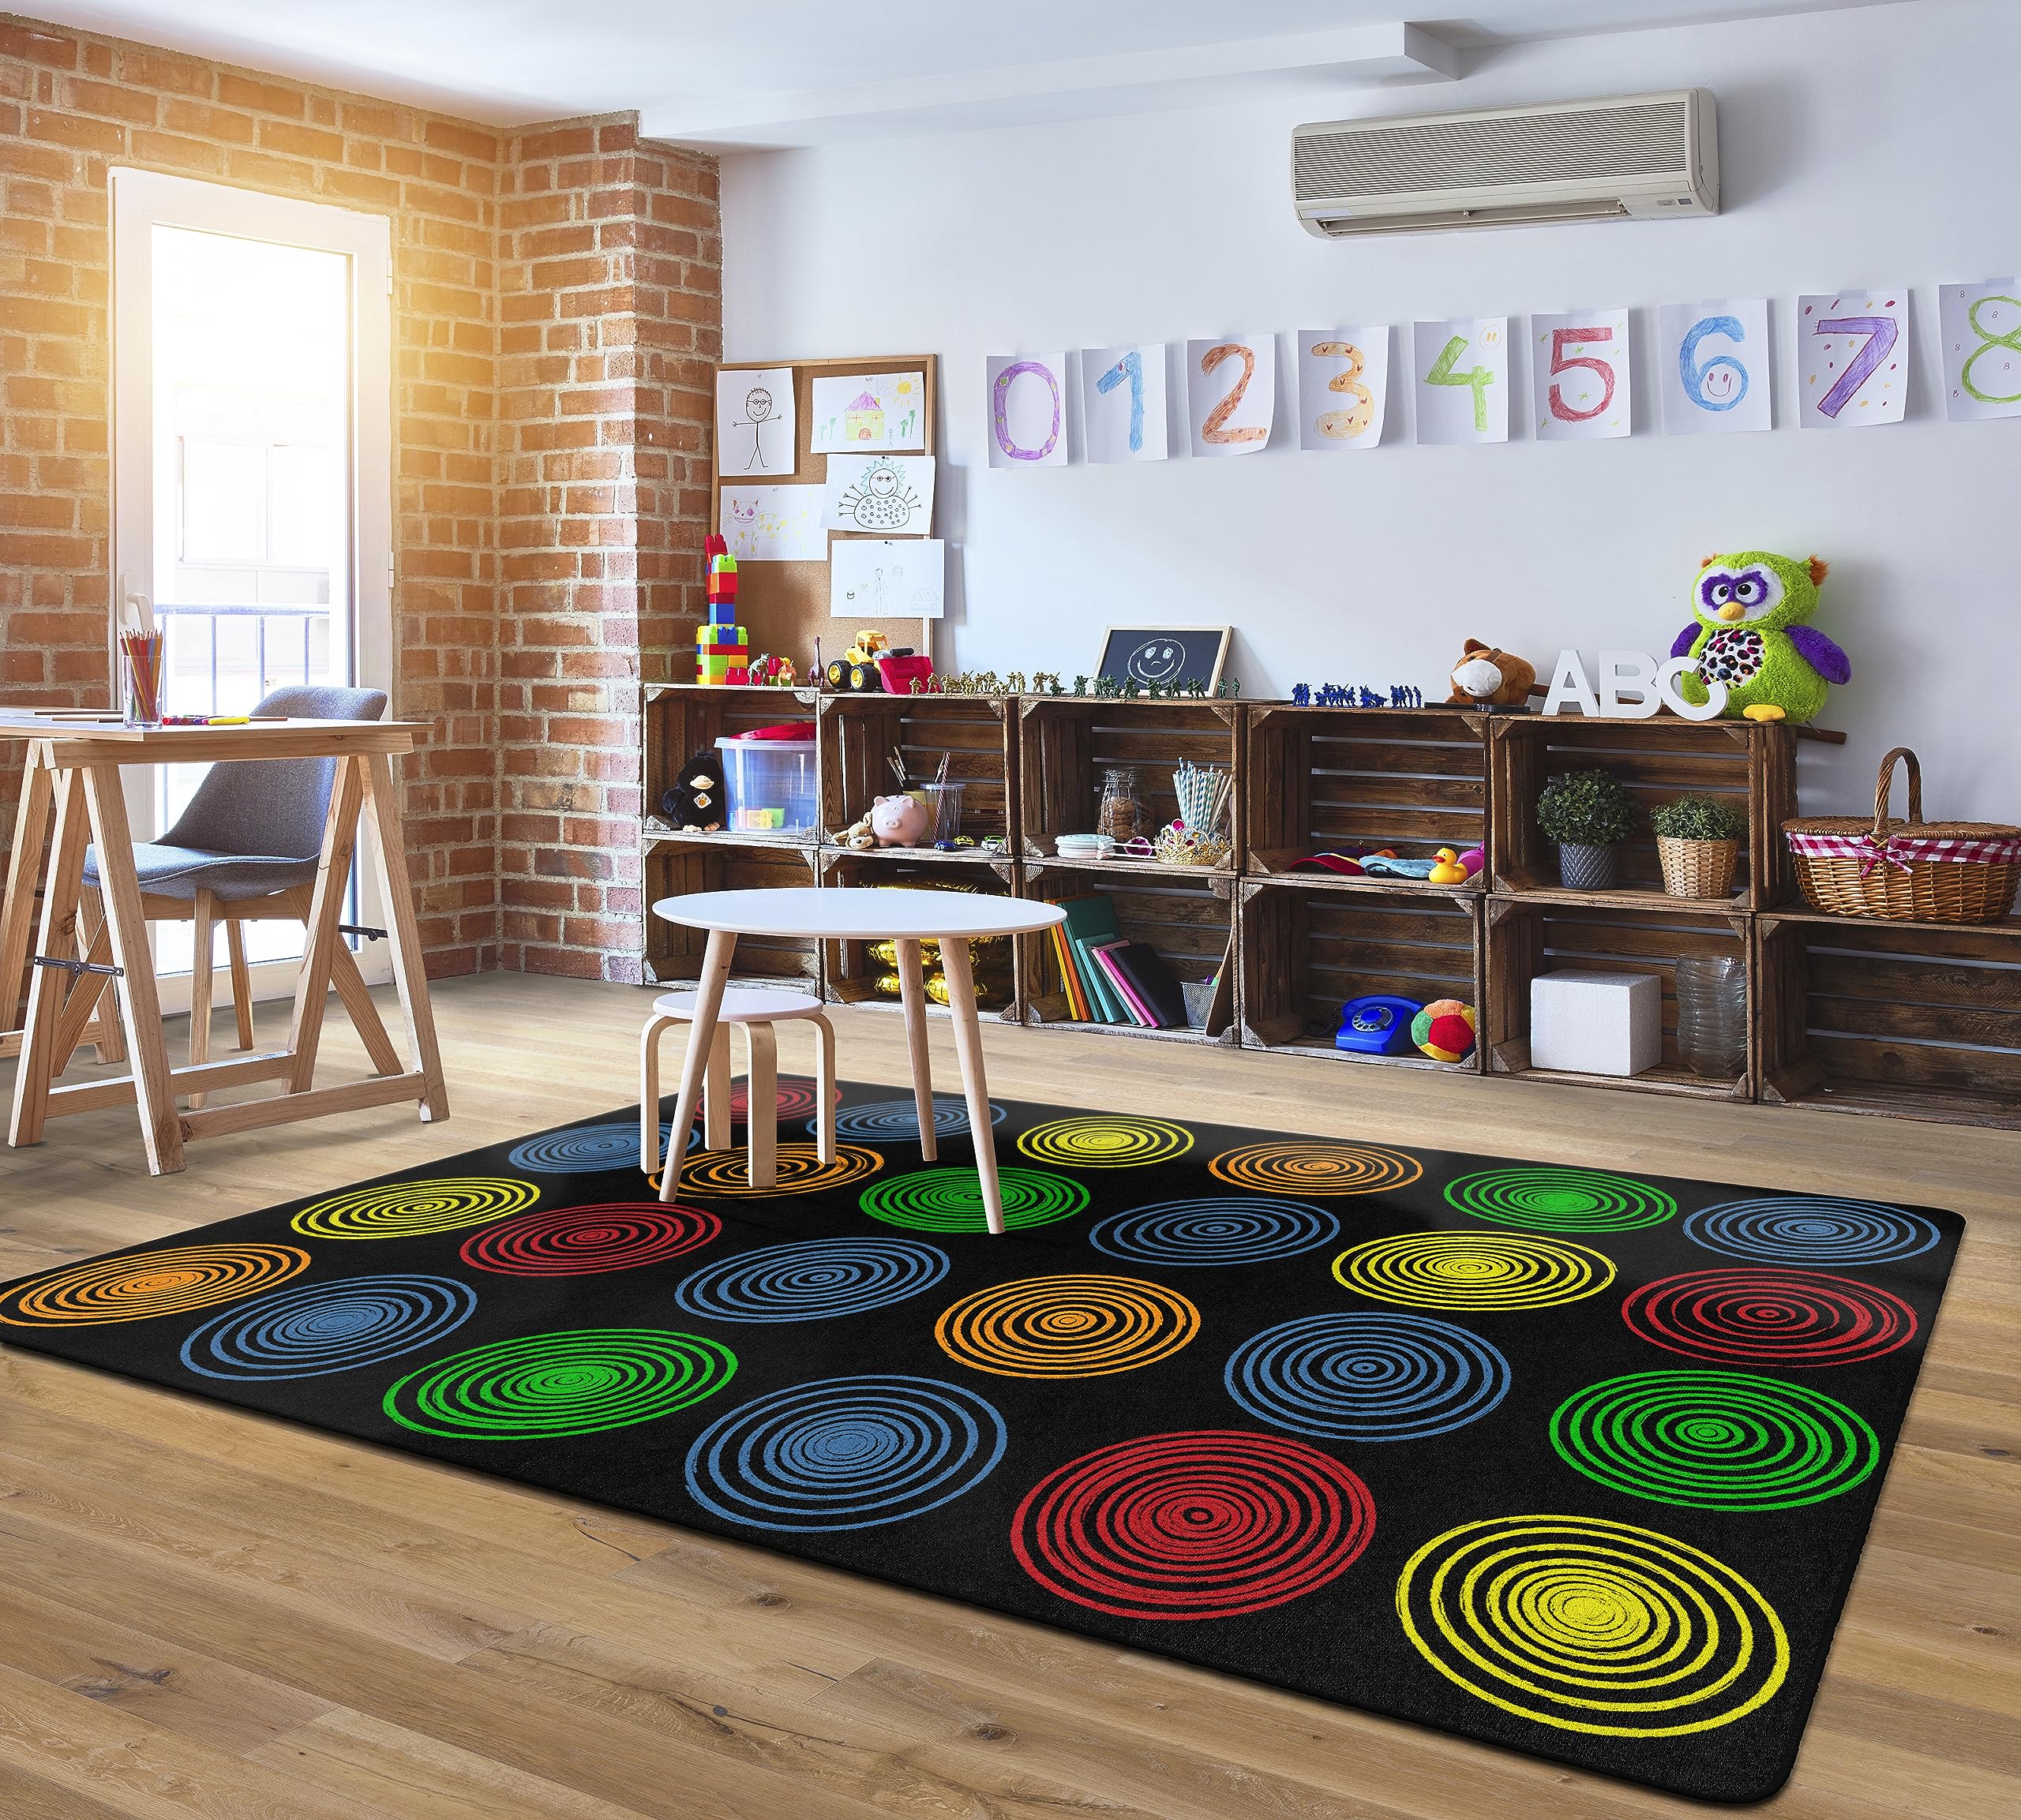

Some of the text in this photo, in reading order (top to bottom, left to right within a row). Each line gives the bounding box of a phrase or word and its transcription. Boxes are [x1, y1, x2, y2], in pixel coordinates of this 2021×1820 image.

[992, 294, 2021, 462] 0 1 2 3 4 5 6 7 8
[1541, 650, 1729, 721] ABC
